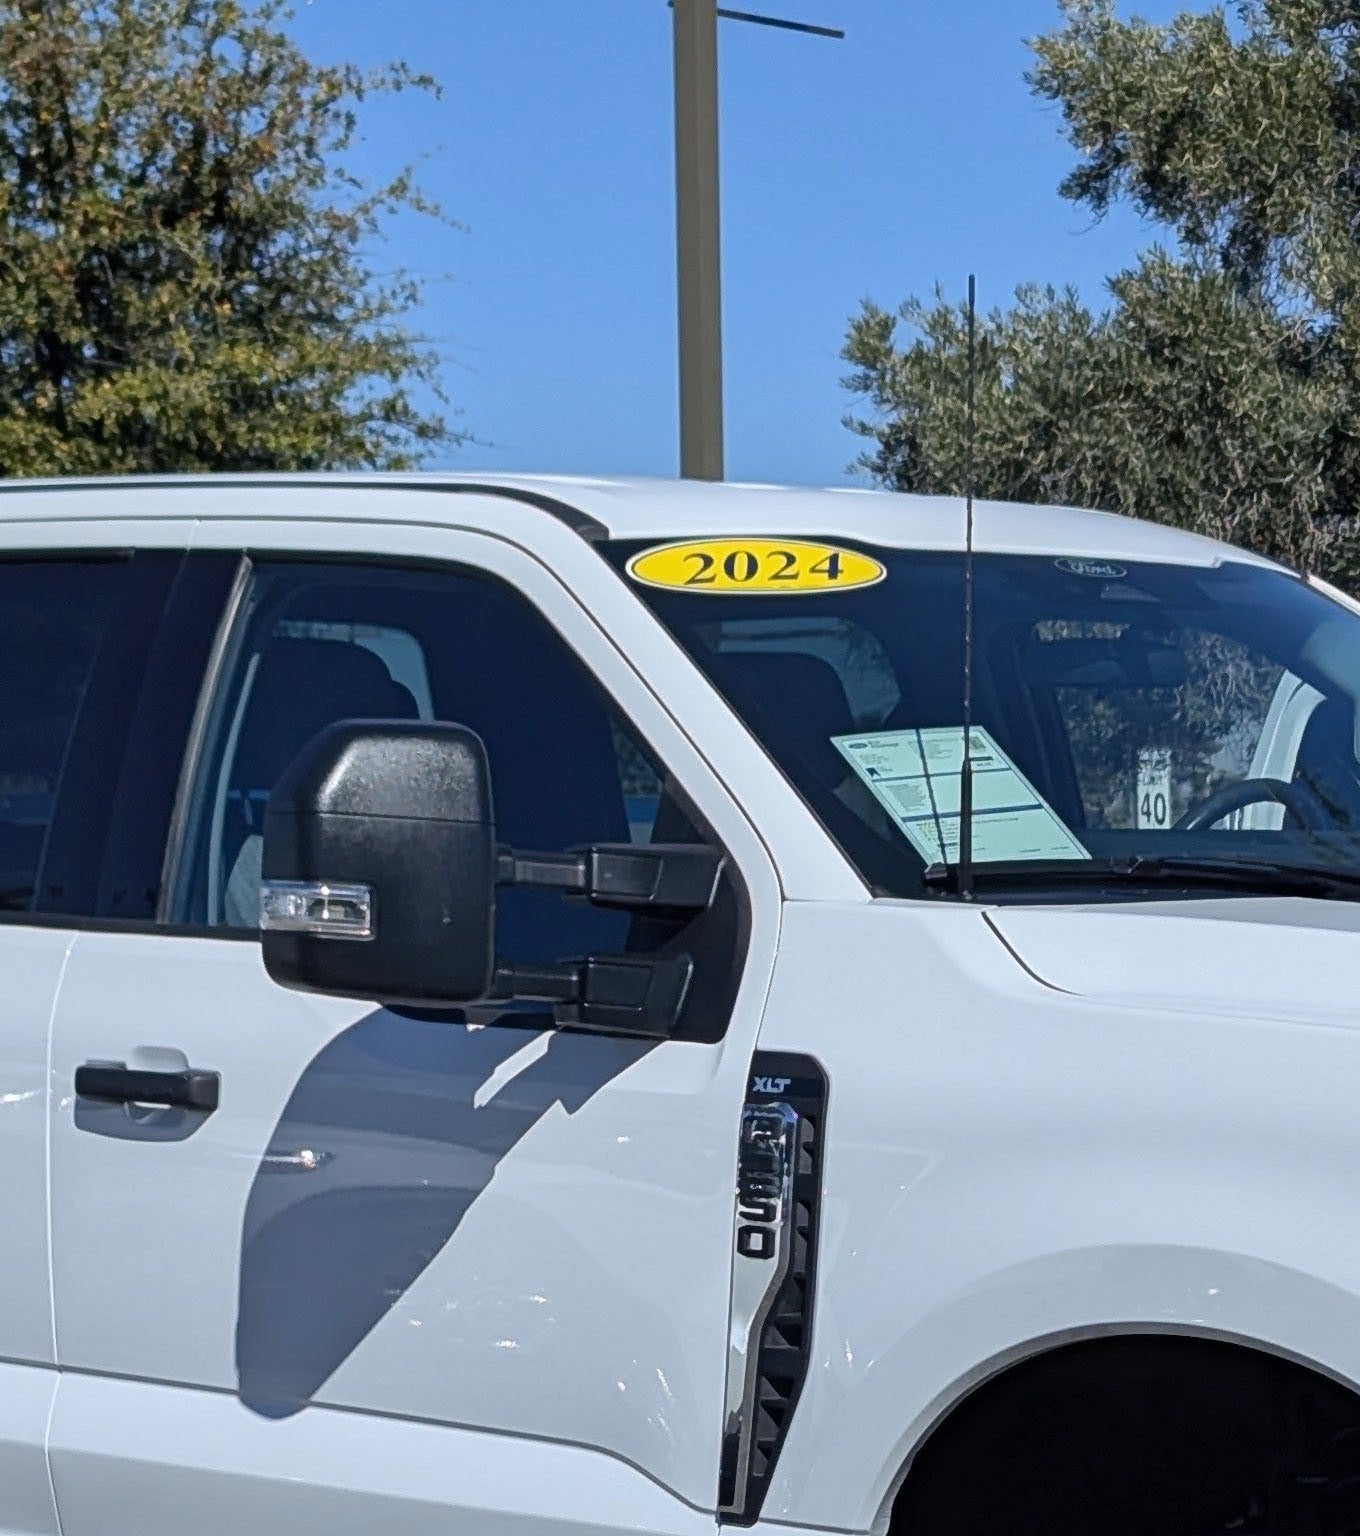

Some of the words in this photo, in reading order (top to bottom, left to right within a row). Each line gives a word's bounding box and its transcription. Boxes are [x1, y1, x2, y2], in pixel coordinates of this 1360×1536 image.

[683, 550, 844, 586] 2024
[1141, 792, 1167, 826] 40
[752, 1075, 791, 1093] XLT
